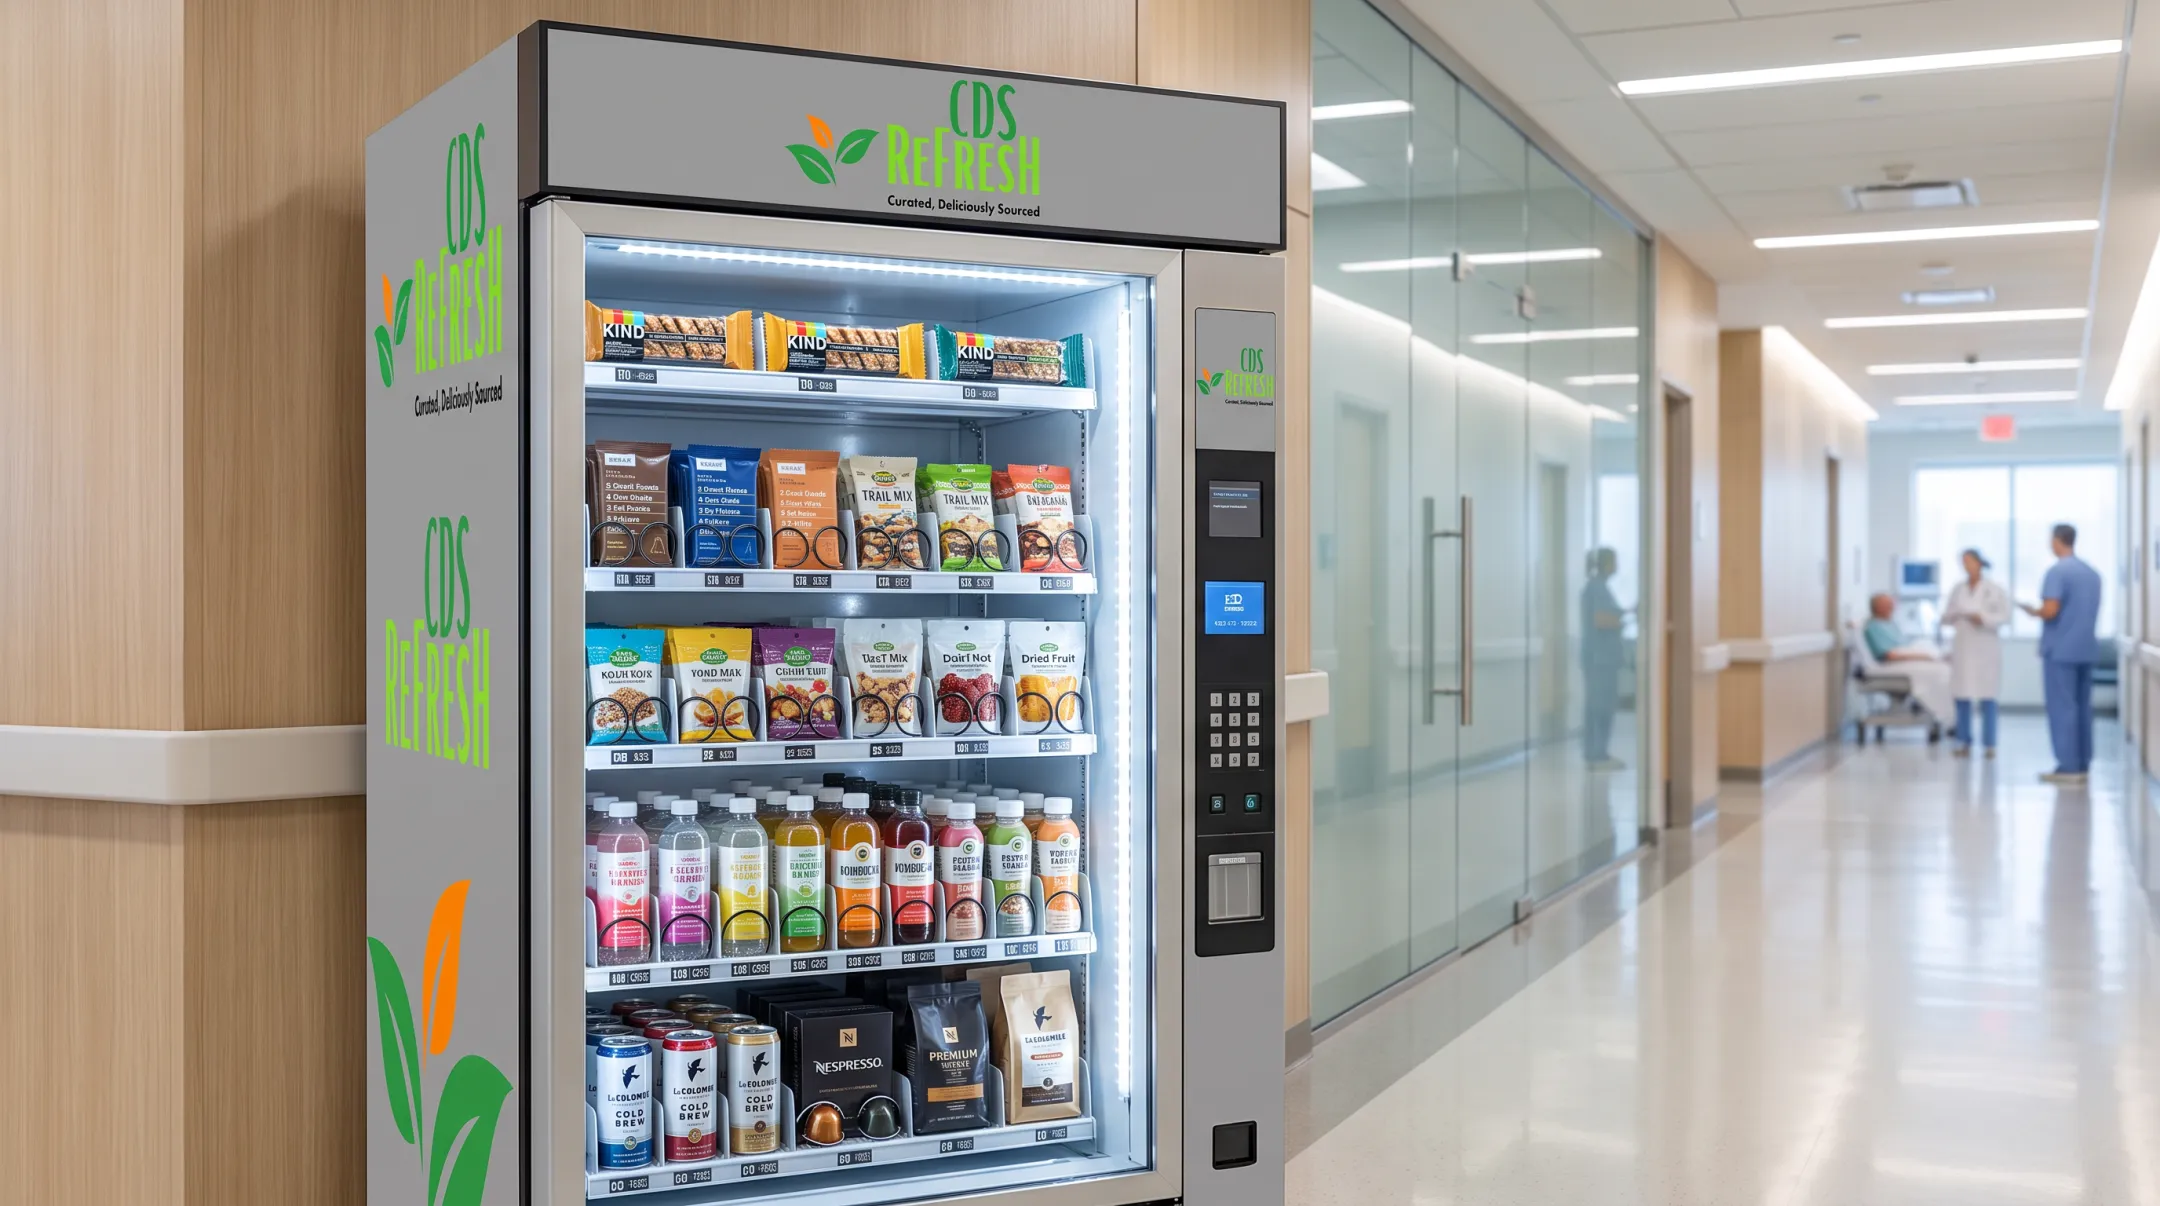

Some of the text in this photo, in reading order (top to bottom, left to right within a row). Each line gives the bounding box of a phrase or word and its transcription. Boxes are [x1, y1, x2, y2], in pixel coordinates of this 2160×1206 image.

[950, 79, 1017, 141] CDS
[446, 122, 486, 255] CDS
[887, 195, 1040, 217] Curated, Deliciously Sourced
[603, 323, 645, 339] KIND
[787, 335, 827, 350] KIND
[957, 346, 994, 360] KIND
[1240, 347, 1264, 373] CDS
[474, 375, 503, 404] Sourced
[862, 489, 913, 502] TRAIL MIX
[943, 493, 990, 506] TRAIL MIX
[972, 653, 992, 663] Not
[1021, 654, 1076, 663] Dried Fruit
[929, 1049, 978, 1061] PREMIUM
[746, 1094, 773, 1104] COLD
[680, 1101, 709, 1112] COLD
[745, 1103, 774, 1113] BREW
[615, 1109, 644, 1119] COLD
[679, 1110, 710, 1121] BREW
[615, 1118, 645, 1128] BREW
